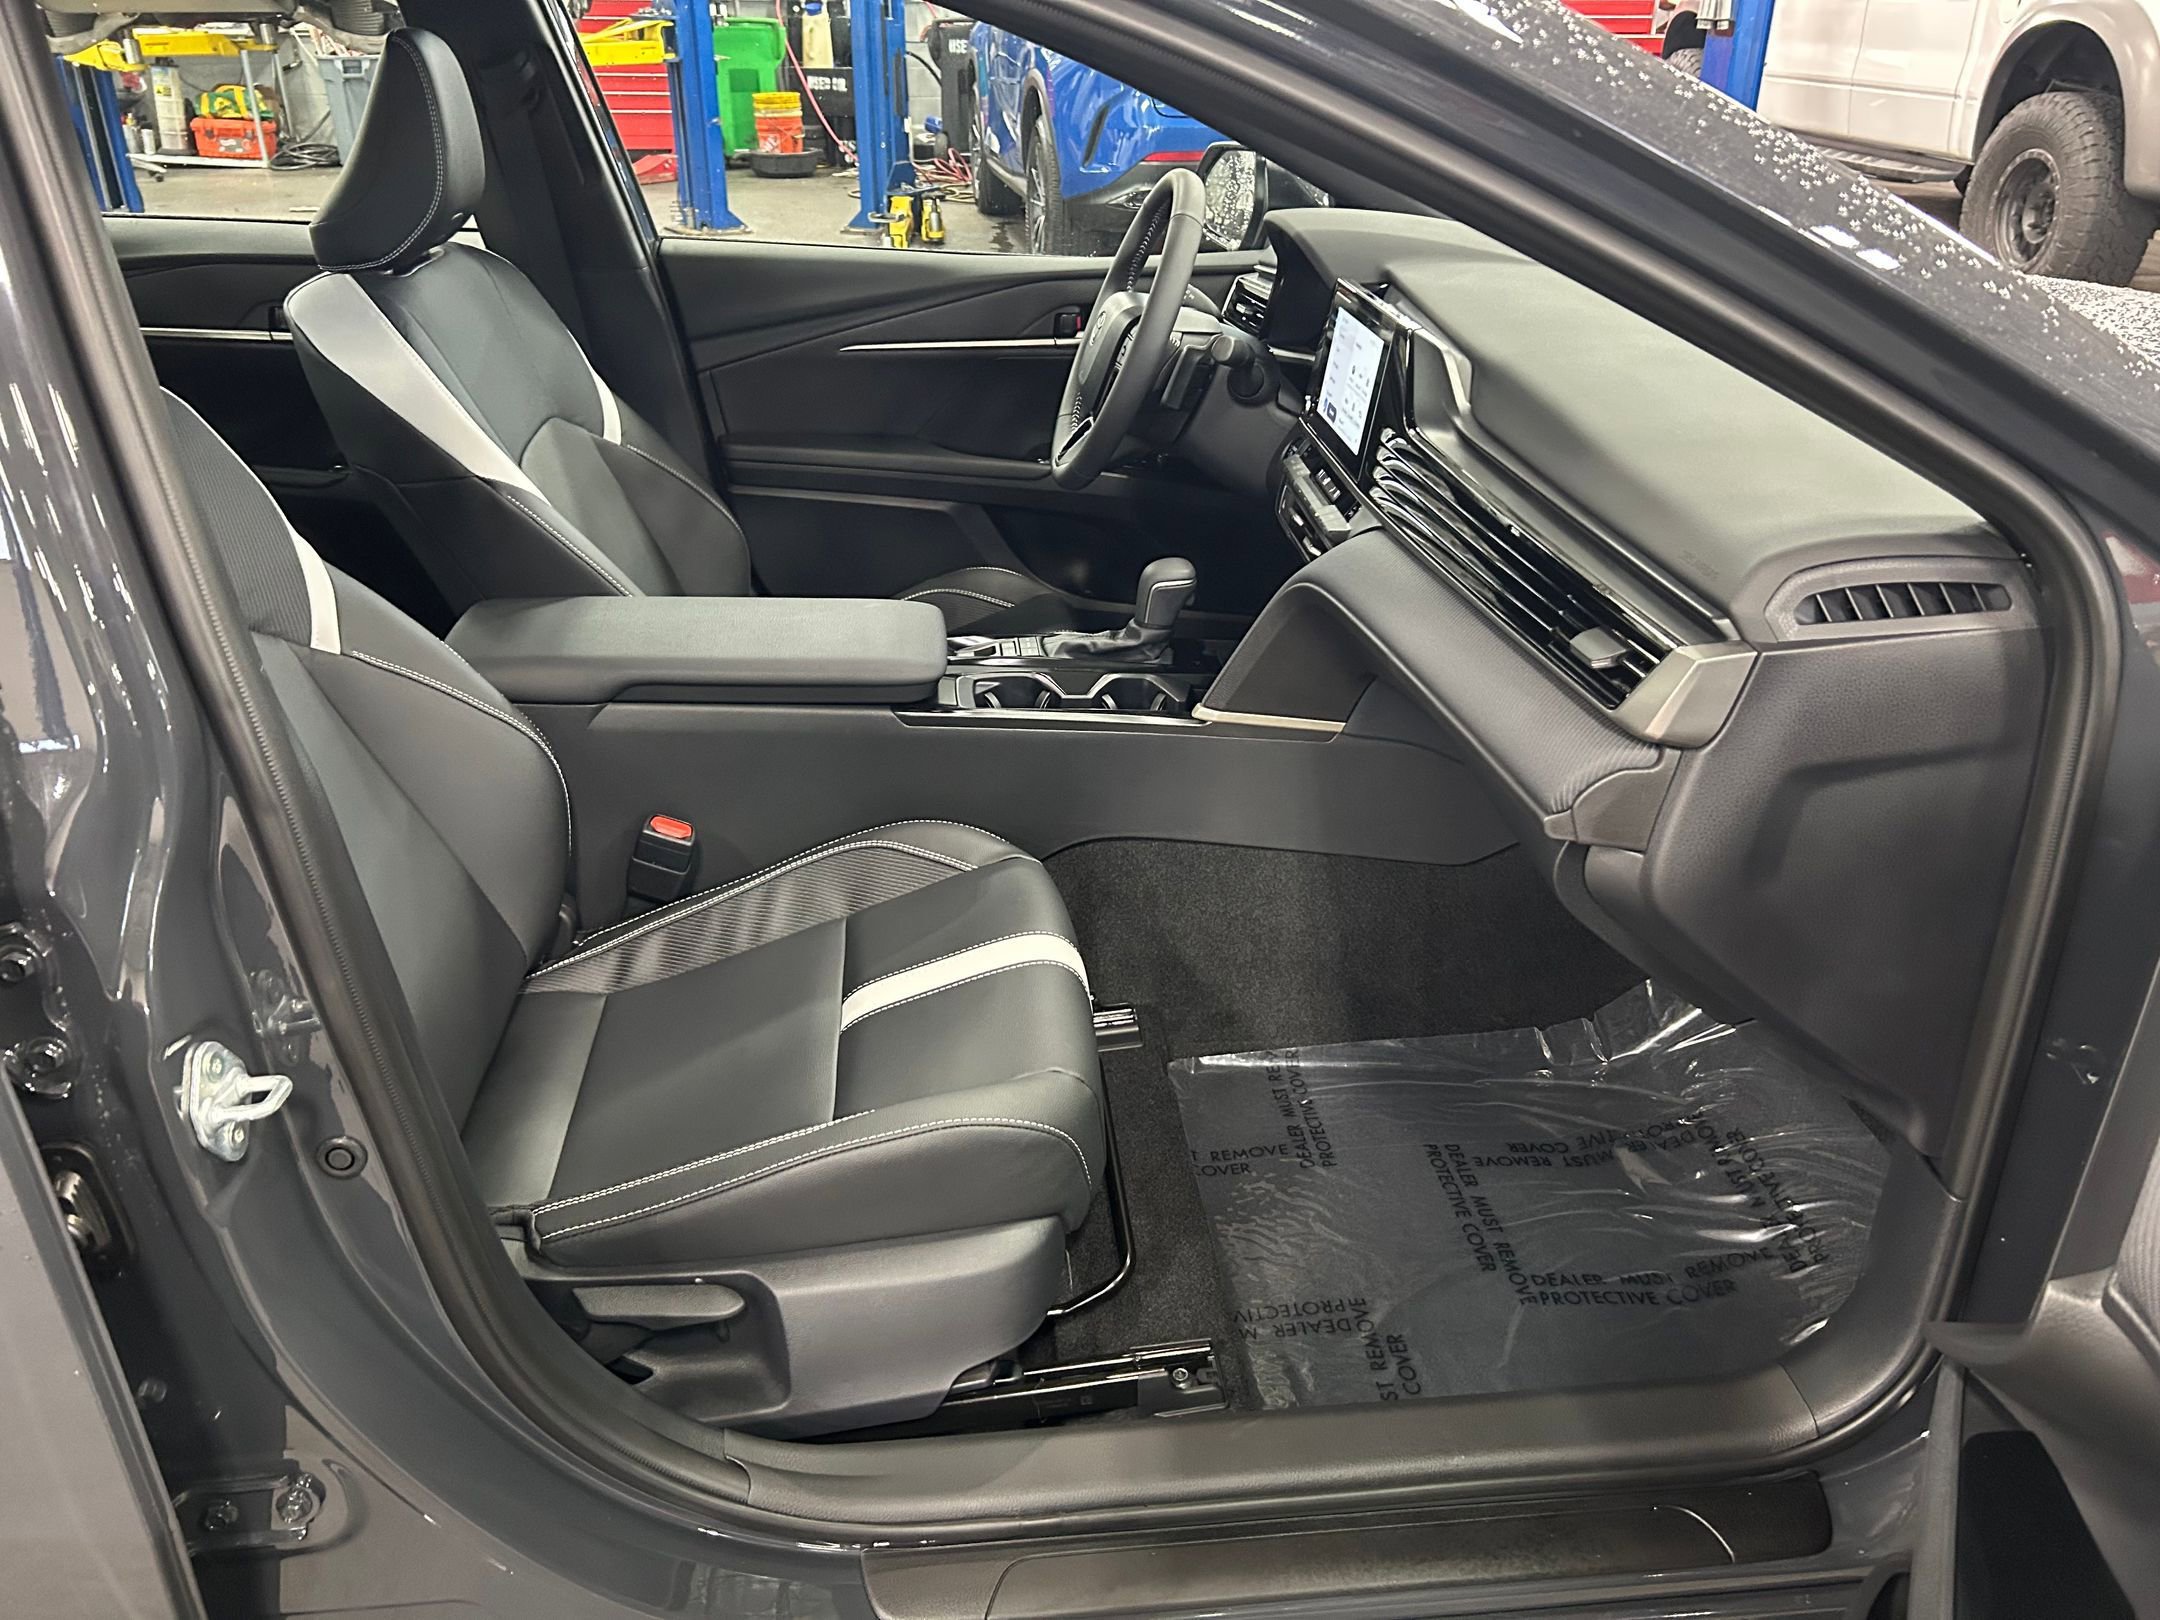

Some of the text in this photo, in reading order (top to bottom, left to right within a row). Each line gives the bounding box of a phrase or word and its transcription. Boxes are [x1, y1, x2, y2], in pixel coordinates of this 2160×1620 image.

[1272, 1088, 1298, 1118] MUST
[1210, 1144, 1289, 1162] REMOVE
[1286, 1124, 1316, 1169] DEALER
[1506, 1141, 1568, 1154] COVER
[1563, 1149, 1614, 1168] MUST
[1473, 1155, 1553, 1168] REMOVE
[1422, 1143, 1497, 1272] PROTECTIVE COVER
[1444, 1143, 1538, 1306] DEALER MUST REMOVE
[1540, 1279, 1738, 1306] PROTECTIVE COVER
[1272, 1317, 1351, 1338] DEALER
[1348, 1297, 1389, 1372] REMOVE
[1385, 1334, 1422, 1396] COVER
